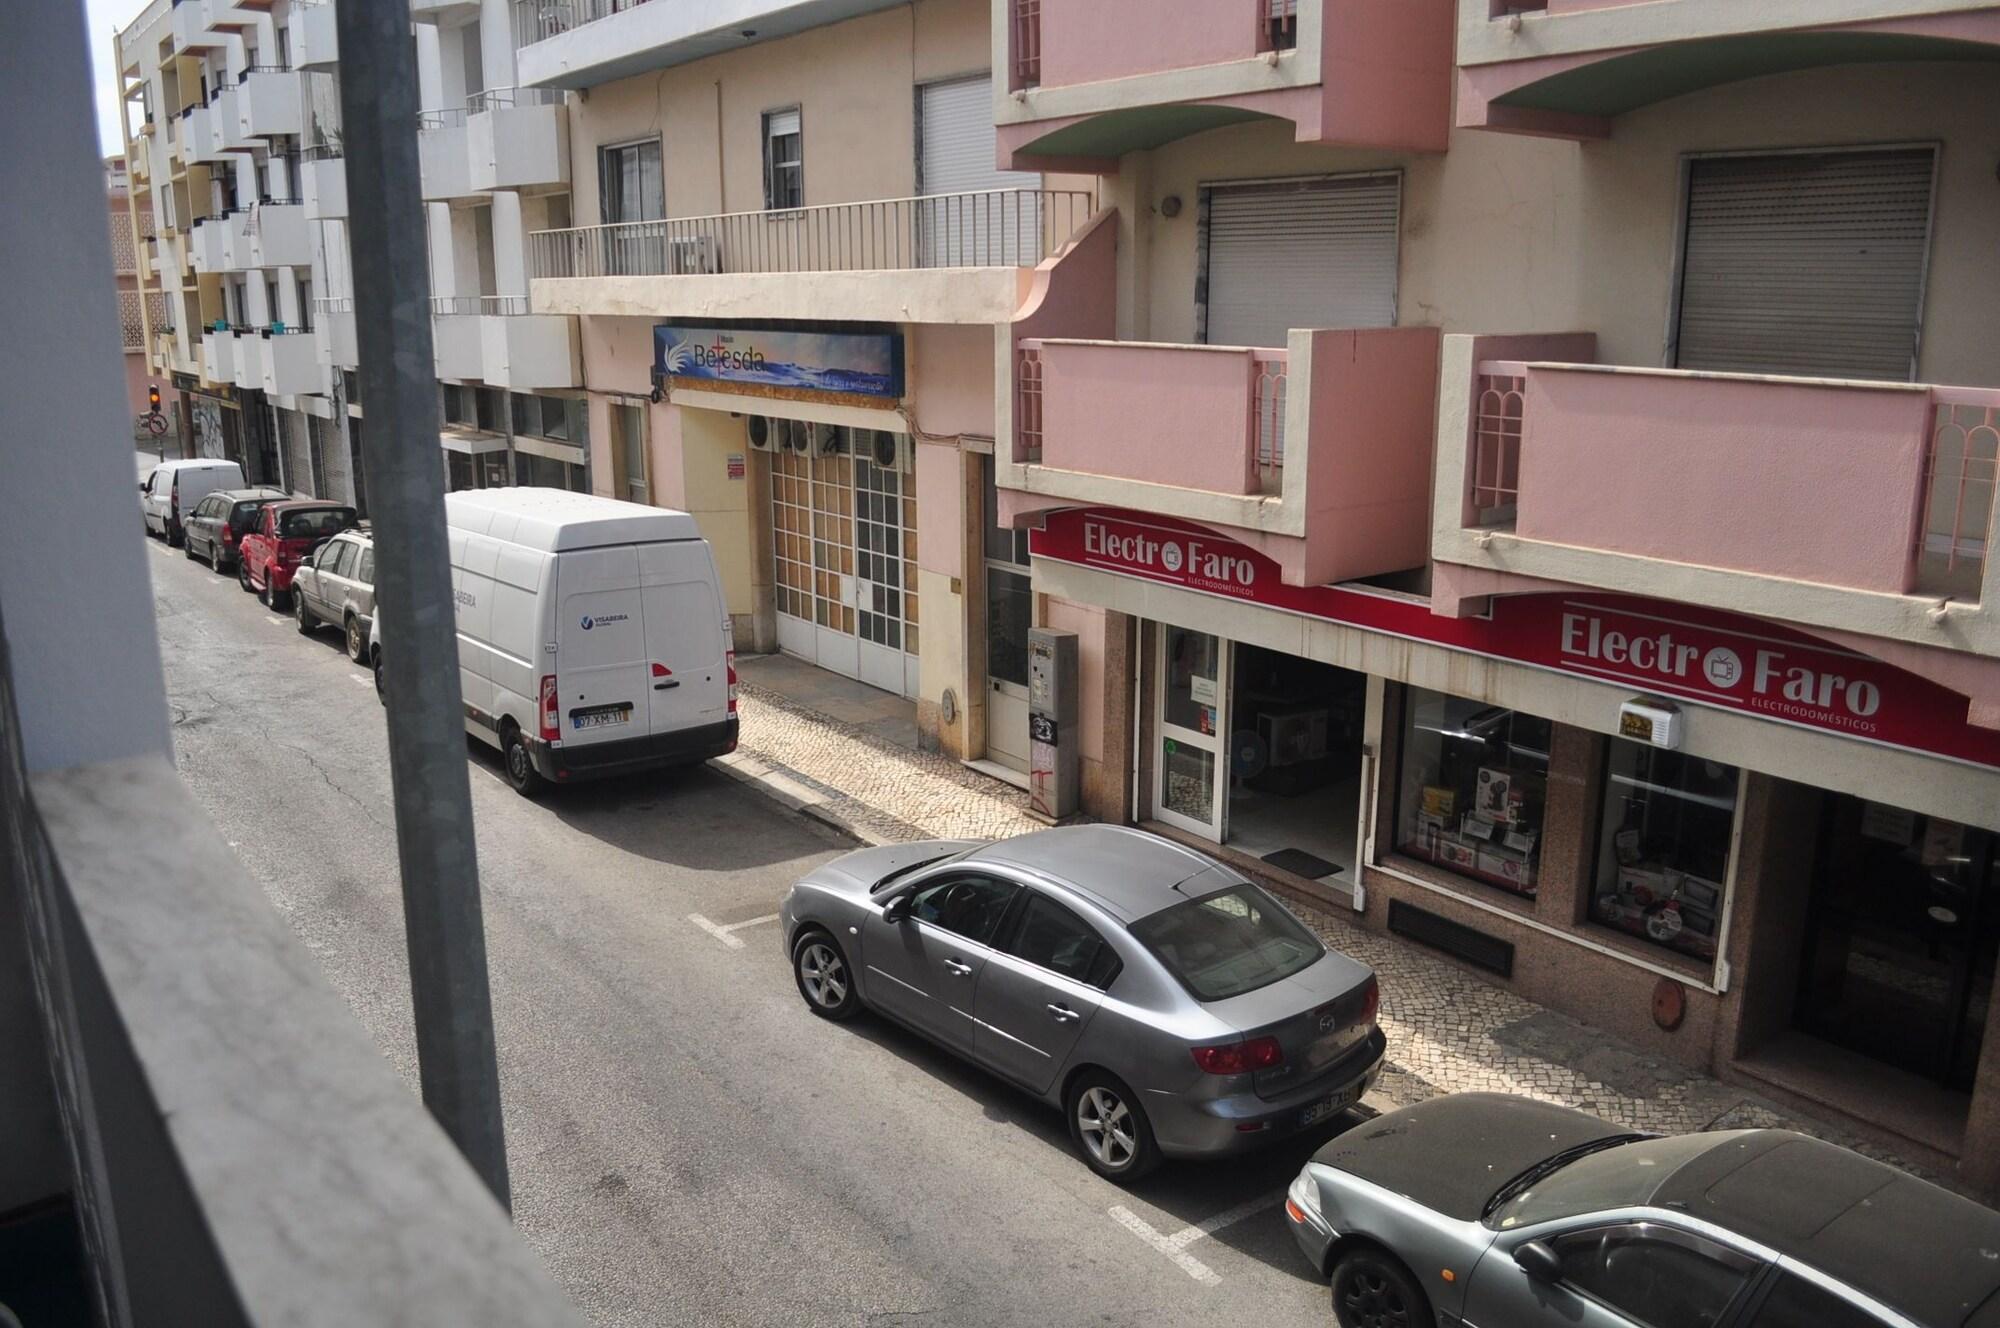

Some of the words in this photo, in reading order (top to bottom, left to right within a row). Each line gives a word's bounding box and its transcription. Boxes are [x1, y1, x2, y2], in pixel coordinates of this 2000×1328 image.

[1188, 542, 1254, 585] Faro
[1187, 576, 1255, 597] ELECTRODOMÉSTICOS
[1753, 649, 1880, 716] Faro
[1751, 698, 1877, 733] ELECTRODOMÉSTICOS
